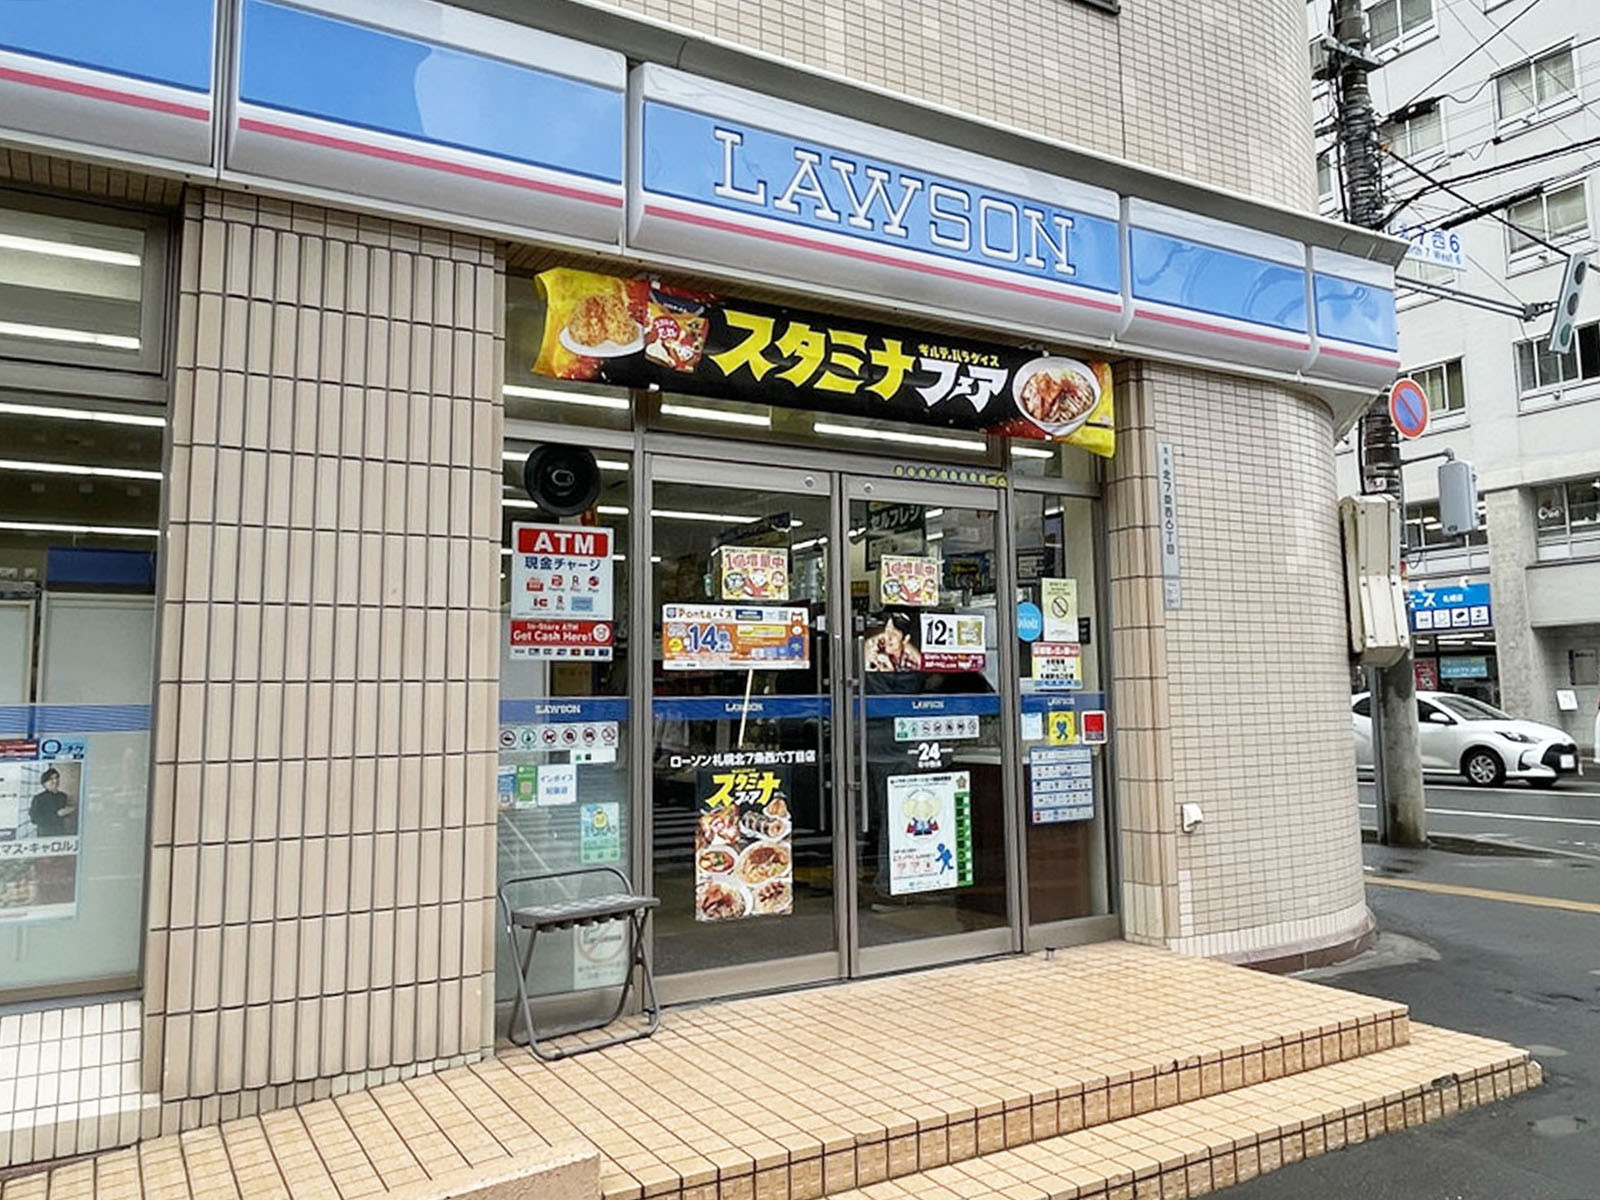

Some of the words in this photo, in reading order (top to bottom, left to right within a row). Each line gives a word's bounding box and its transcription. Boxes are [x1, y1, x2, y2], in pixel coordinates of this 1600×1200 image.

[713, 126, 1076, 275] LAWSON
[534, 531, 595, 555] ATM
[524, 556, 601, 572] 現金チャージ
[513, 630, 531, 641] Get
[534, 631, 561, 642] Cash
[562, 632, 593, 643] Here!
[918, 742, 941, 760] 24
